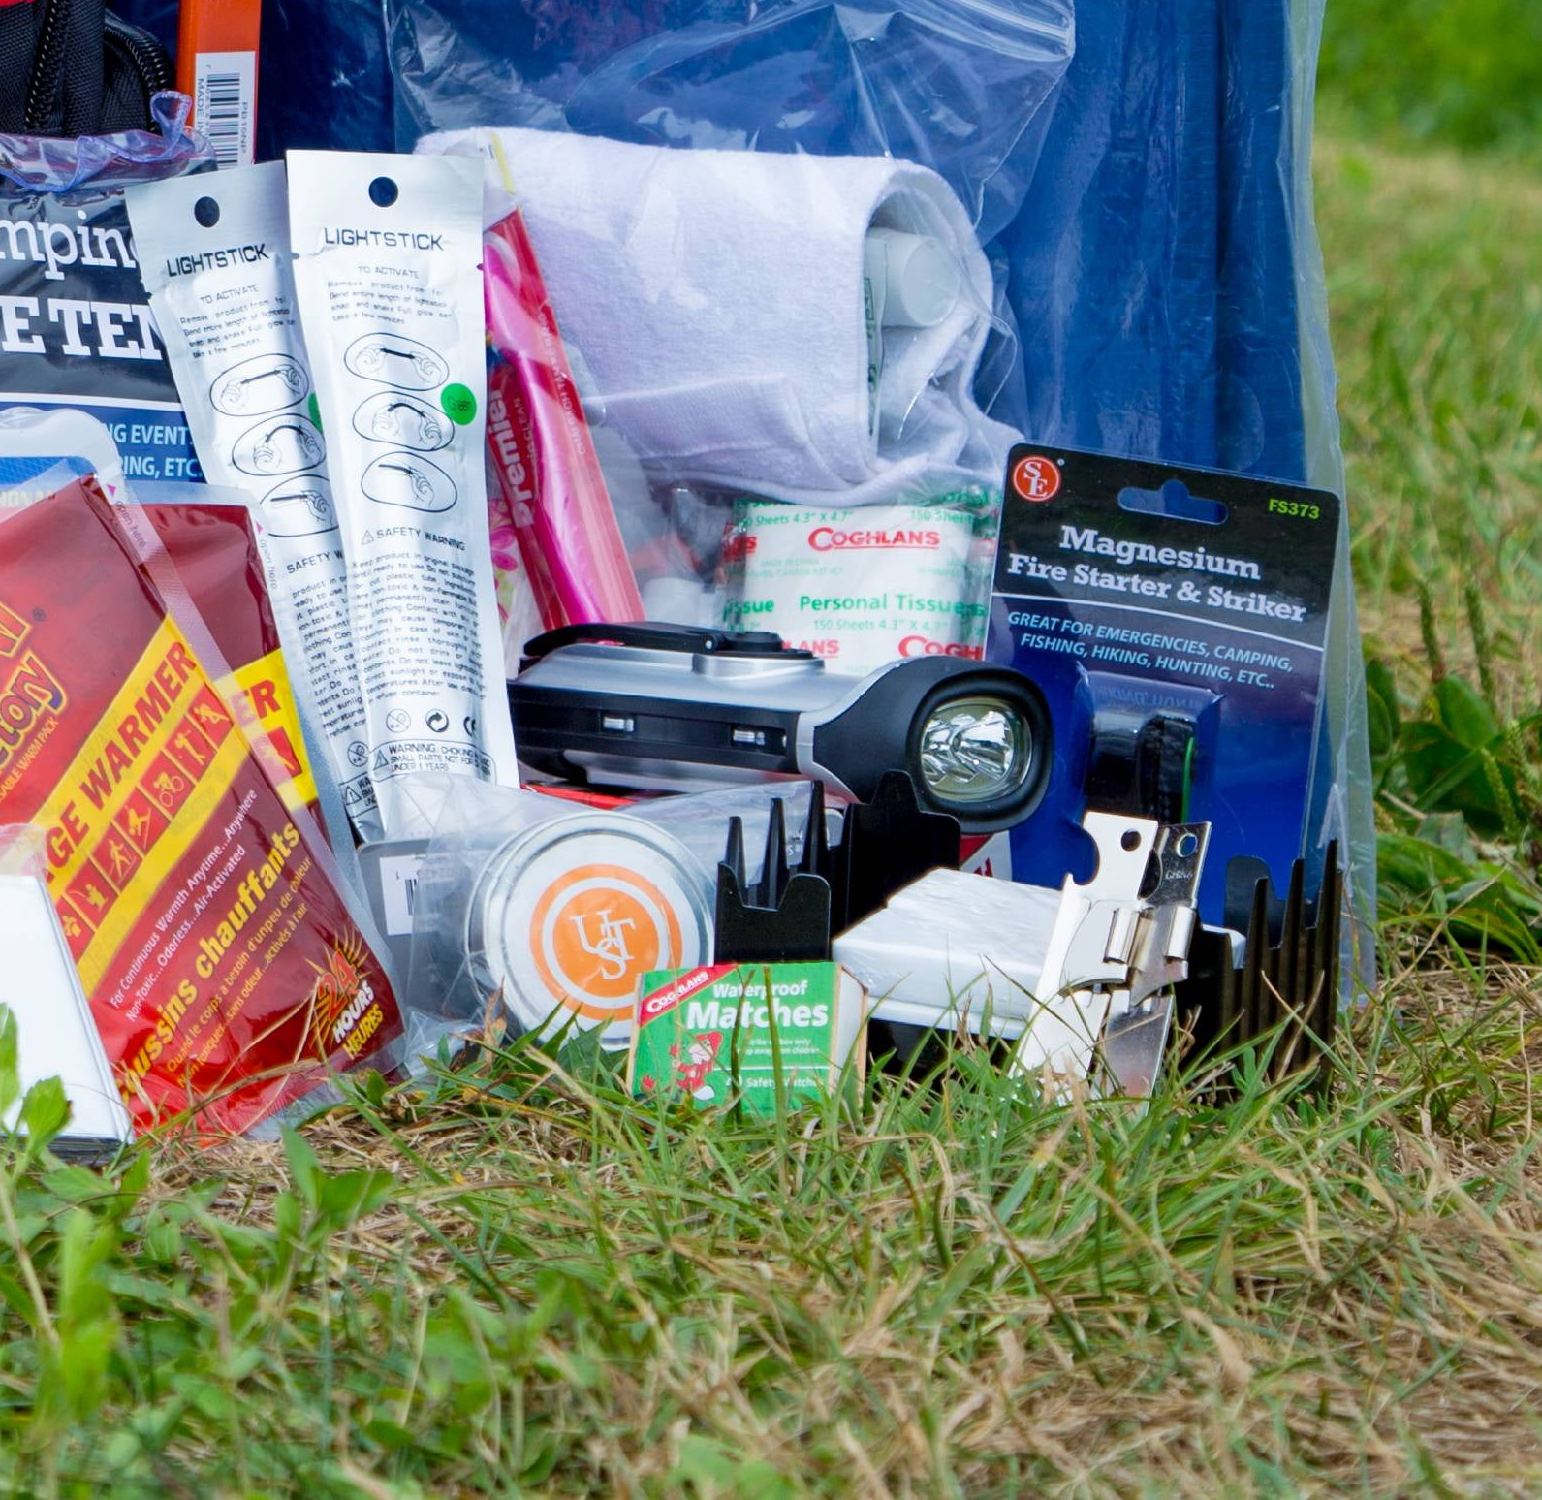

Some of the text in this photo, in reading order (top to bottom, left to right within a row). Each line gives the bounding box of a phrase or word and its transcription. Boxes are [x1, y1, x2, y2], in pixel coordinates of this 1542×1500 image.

[324, 227, 444, 251] LIGHTSTICK
[167, 244, 269, 277] LIGHTSTICK
[374, 266, 420, 279] ACTIVATE
[216, 284, 260, 301] ACTIVATE
[49, 297, 166, 361] TEN
[1268, 498, 1321, 520] FS373
[376, 527, 466, 551] SAFETY WARNING
[1059, 525, 1262, 581] Magnesium
[286, 553, 330, 574] SAFETY
[800, 594, 888, 612] Personal
[1007, 553, 1307, 624] Fire Starter & Striker
[813, 618, 874, 630] 150 Sheets
[1008, 611, 1294, 673] GREAT FOR EMERGENCIES, CAMPING,
[1020, 633, 1089, 659] FISHING,
[1091, 644, 1152, 668] HIKING,
[1155, 655, 1234, 683] HUNTING,
[80, 641, 197, 793] WARMER
[18, 740, 44, 770] WARM
[38, 718, 59, 744] PACK
[195, 822, 300, 979] chauffants
[110, 984, 127, 1009] For
[120, 928, 161, 991] Continuous
[156, 889, 189, 932] Warmth
[712, 980, 808, 999] Waterproof
[332, 979, 375, 1044] HOURS
[343, 1003, 384, 1060] HEURES
[686, 1001, 829, 1030] Matches
